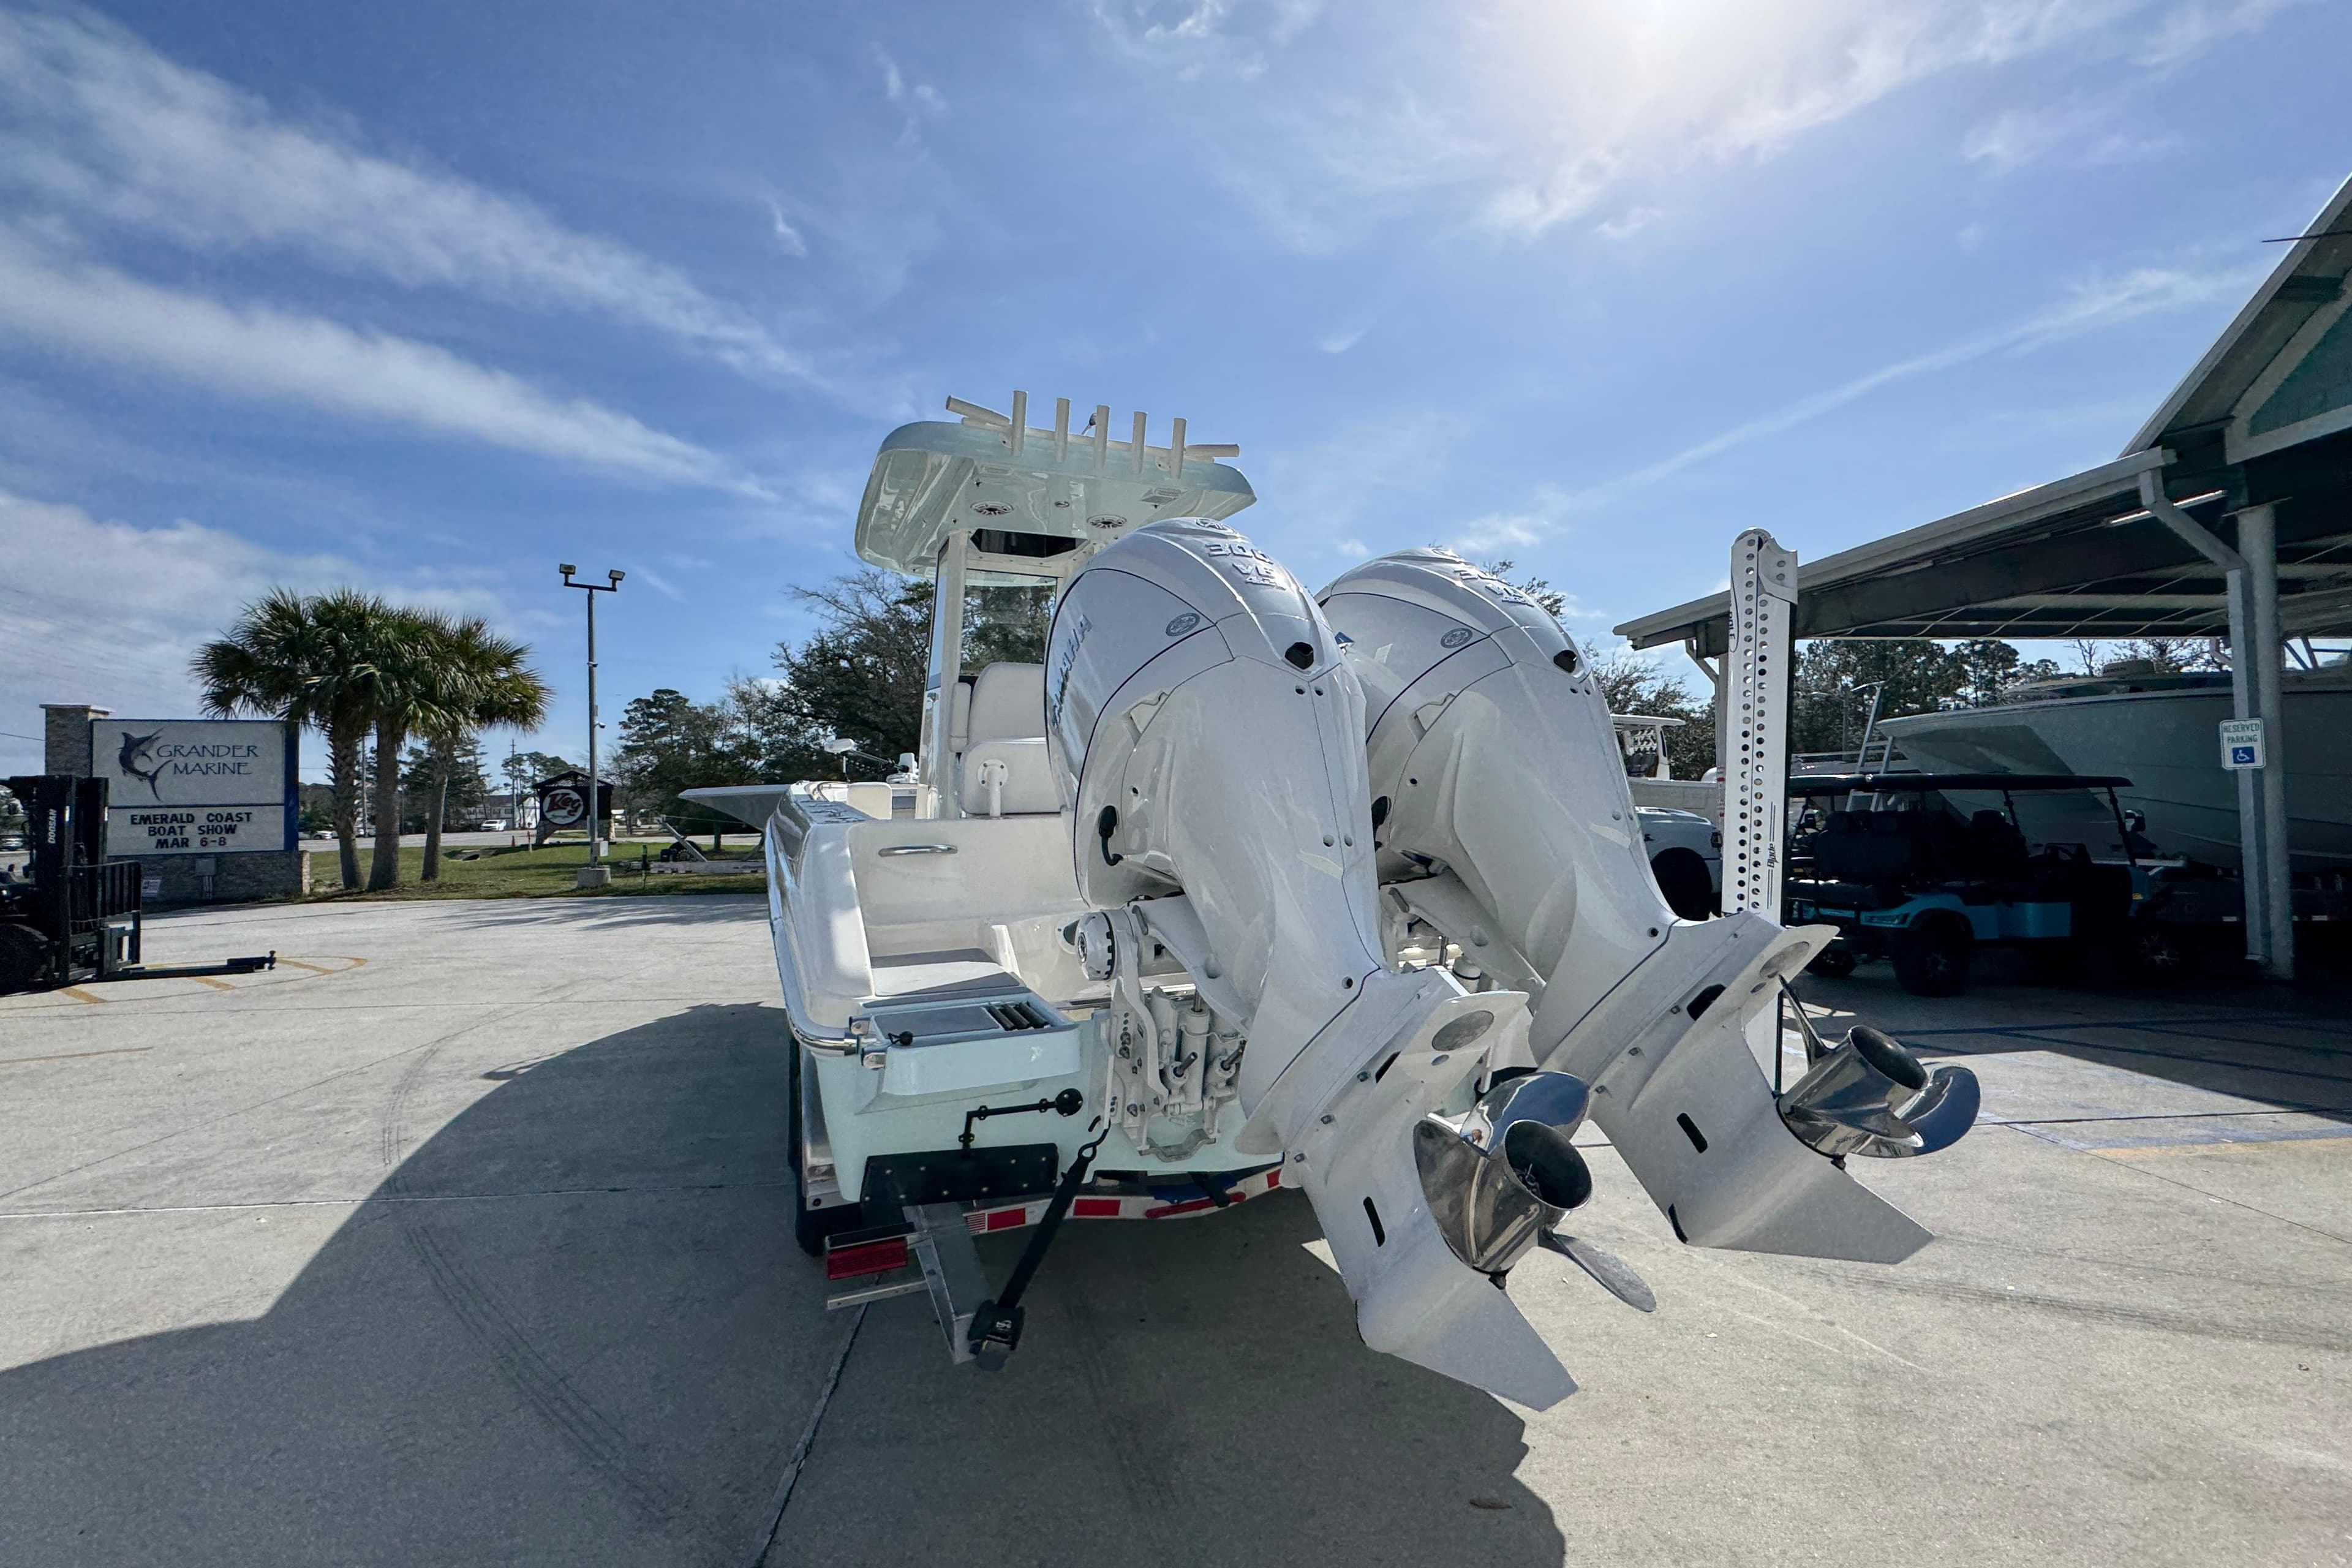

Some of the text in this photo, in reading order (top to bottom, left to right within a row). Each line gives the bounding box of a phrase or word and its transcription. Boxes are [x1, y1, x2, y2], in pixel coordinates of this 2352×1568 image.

[2223, 723, 2260, 733] RESERVED
[2227, 734, 2258, 743] PARKING
[156, 744, 259, 758] GRANDER
[173, 762, 253, 775] MARINE
[545, 793, 581, 816] Keg
[130, 812, 252, 825] EMERALD COAST
[47, 809, 58, 844] DOOSAN
[148, 824, 238, 837] BOAT SHOW
[155, 837, 227, 849] MAR 6-8
[1766, 843, 1779, 869] Blade
